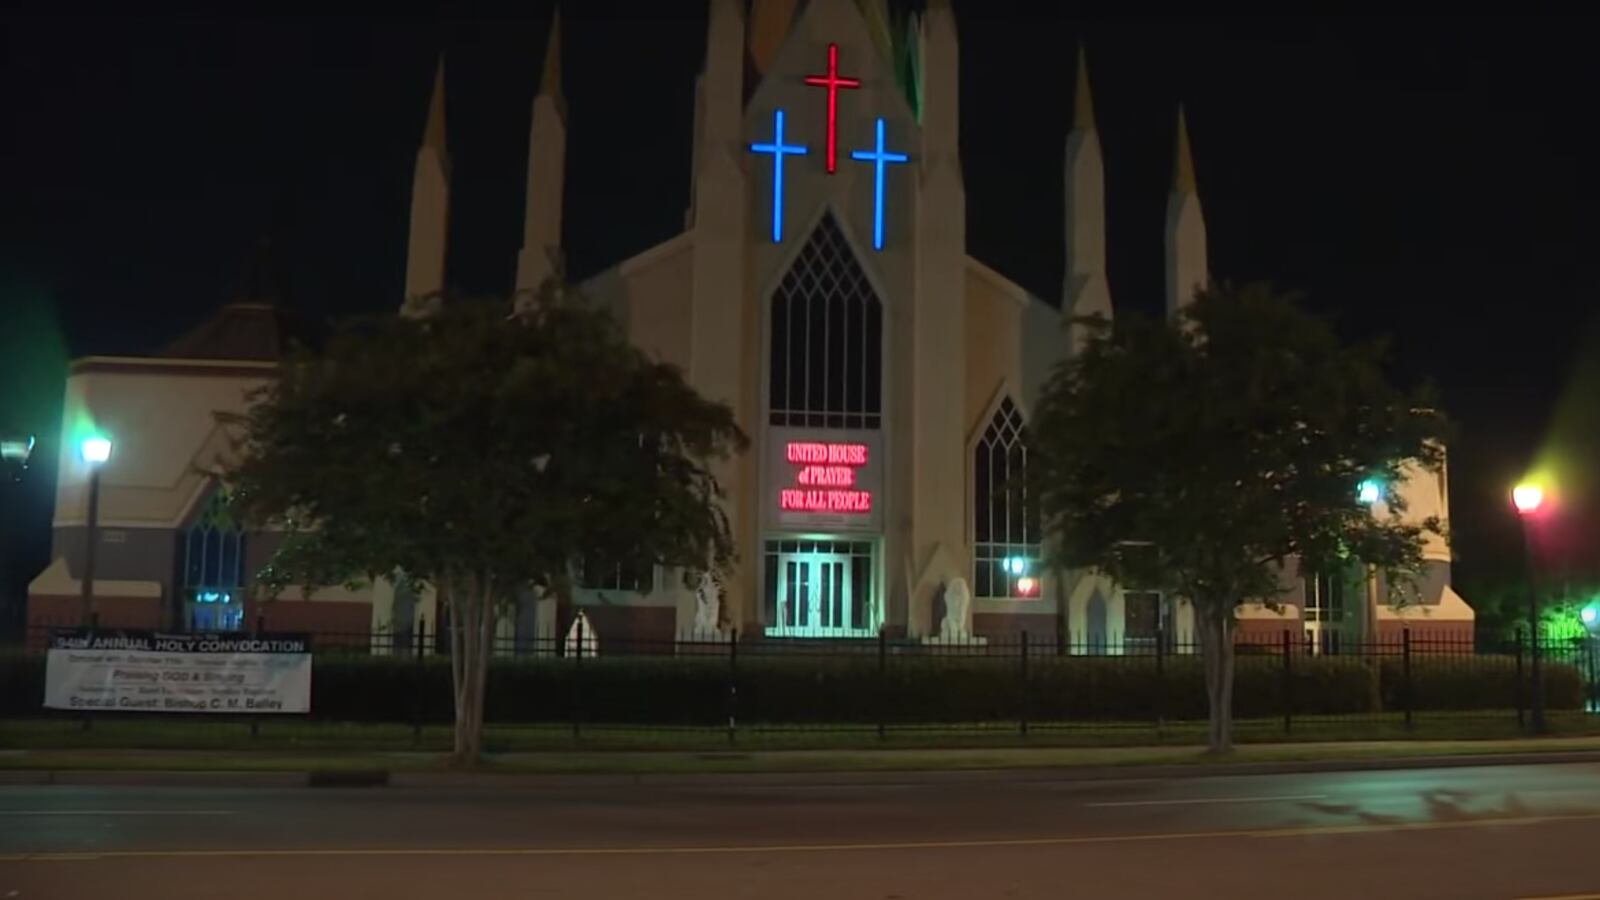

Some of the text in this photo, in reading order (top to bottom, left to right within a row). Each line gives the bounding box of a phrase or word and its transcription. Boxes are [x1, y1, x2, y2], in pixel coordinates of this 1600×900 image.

[787, 443, 866, 463] UNITED HOUSE
[799, 466, 852, 485] of PRAYER
[782, 489, 870, 510] FOR ALL PEOPLE
[92, 637, 151, 650] ANNUAL
[156, 639, 196, 651] HOLY
[199, 640, 305, 652] CONVOCATION
